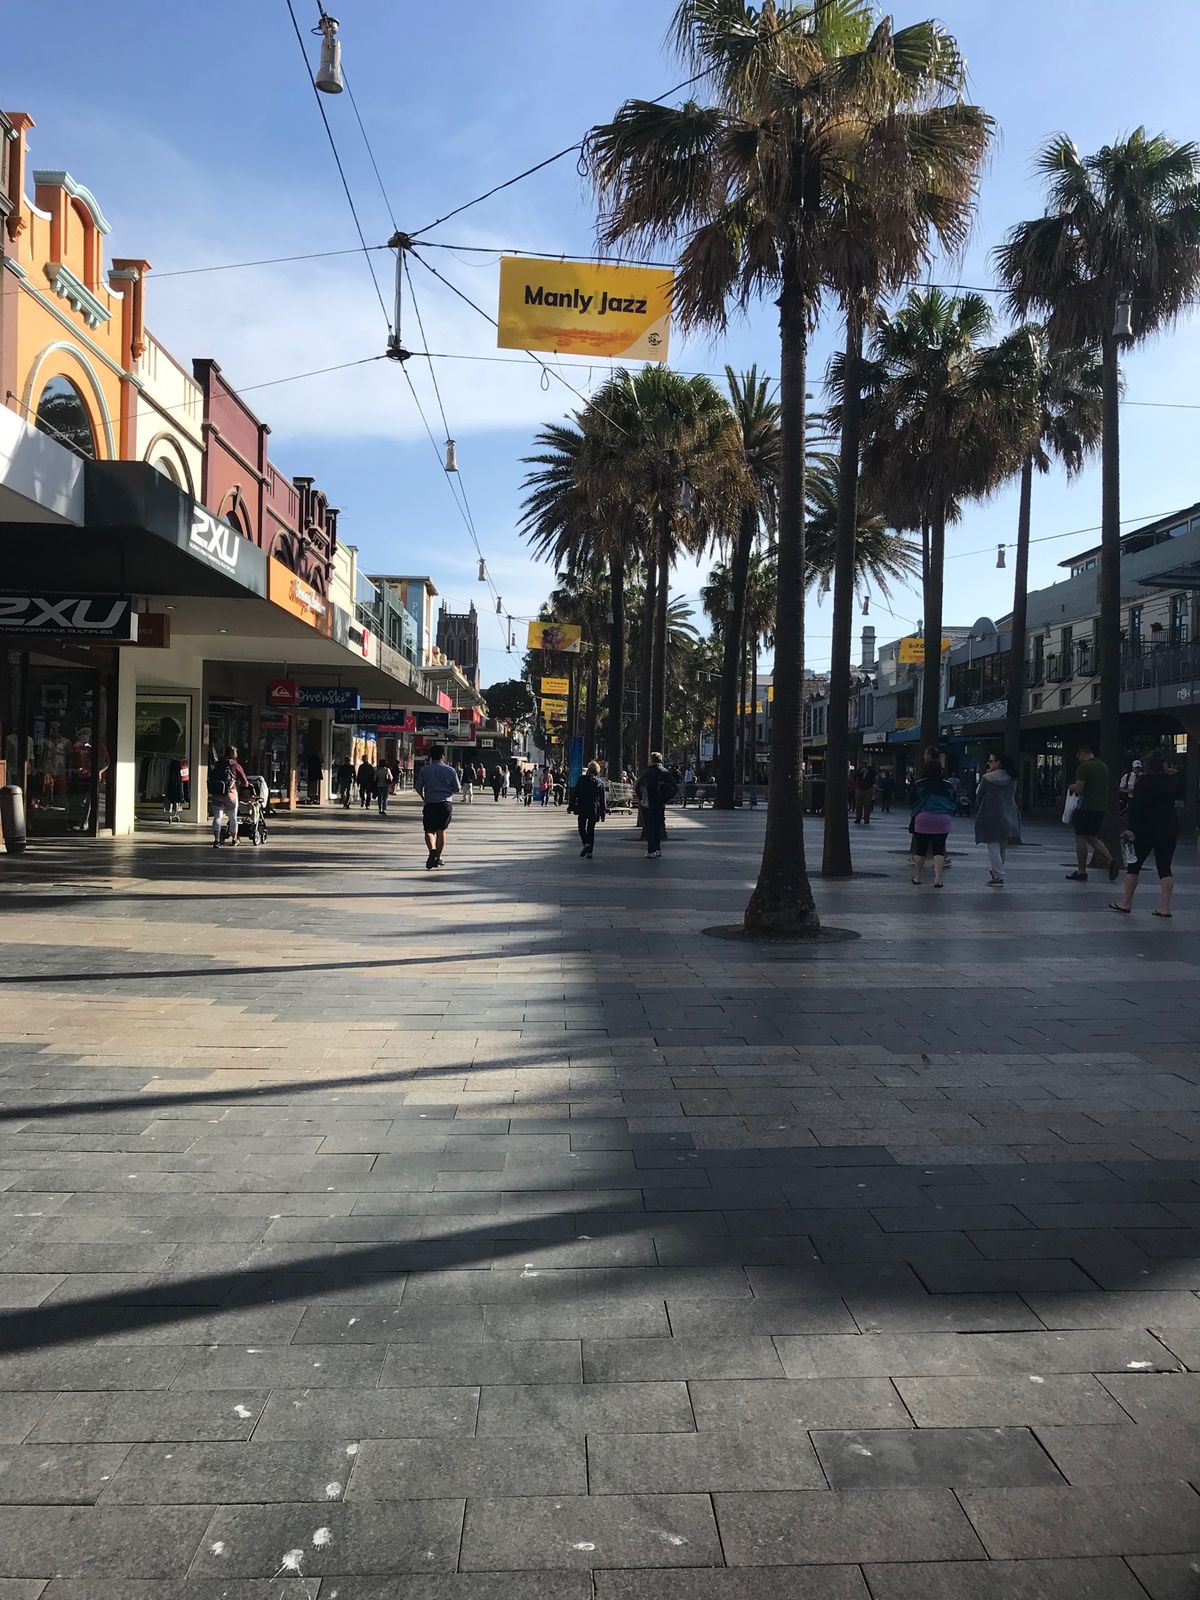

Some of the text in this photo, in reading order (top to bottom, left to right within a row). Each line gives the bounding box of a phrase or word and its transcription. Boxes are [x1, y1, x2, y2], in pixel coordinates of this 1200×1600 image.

[524, 285, 648, 316] Manly Jazz
[190, 505, 240, 567] 2XU
[0, 596, 128, 628] 2XU
